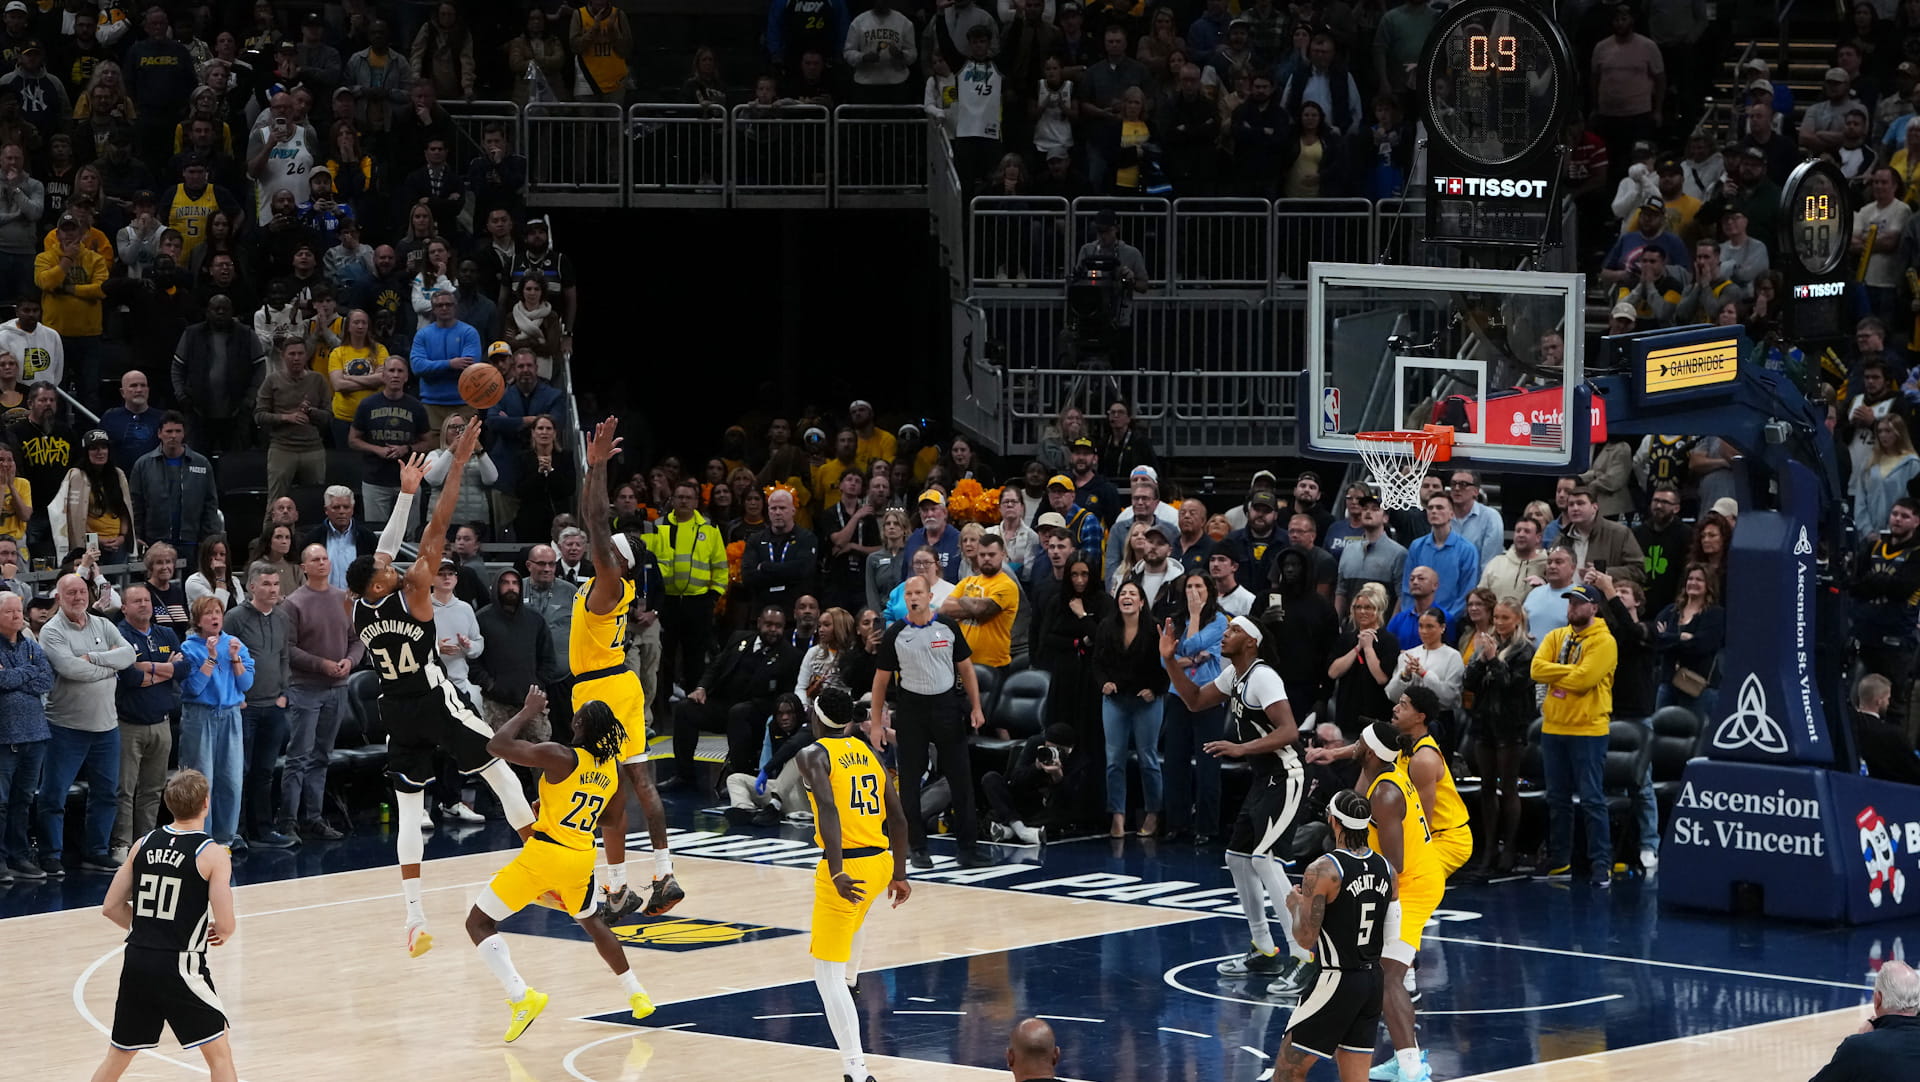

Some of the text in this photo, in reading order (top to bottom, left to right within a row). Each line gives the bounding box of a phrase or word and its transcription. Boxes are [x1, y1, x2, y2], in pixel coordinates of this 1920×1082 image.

[805, 16, 825, 29] 26
[864, 28, 900, 43] PACERS
[140, 56, 178, 66] PACERS
[1470, 35, 1517, 71] 0.9
[975, 84, 992, 96] 43
[287, 163, 305, 176] 26
[1465, 178, 1547, 199] TISSOT
[186, 218, 198, 236] 5
[1809, 282, 1845, 298] TISSOT
[1670, 354, 1724, 377] GAINBRIDGE
[189, 465, 207, 475] PACERS
[372, 642, 420, 680] 34
[1796, 561, 1819, 743] Ascension St. Vincent
[839, 752, 869, 770] SIAKAM
[579, 772, 611, 791] NESMITH
[850, 773, 881, 817] 43
[1676, 781, 1820, 819] Ascension
[559, 791, 604, 832] 23
[1674, 817, 1825, 857] St. Vincent
[146, 848, 186, 869] GREEN
[136, 873, 183, 920] 20
[1346, 874, 1376, 898] TRENT
[1357, 902, 1376, 946] 5
